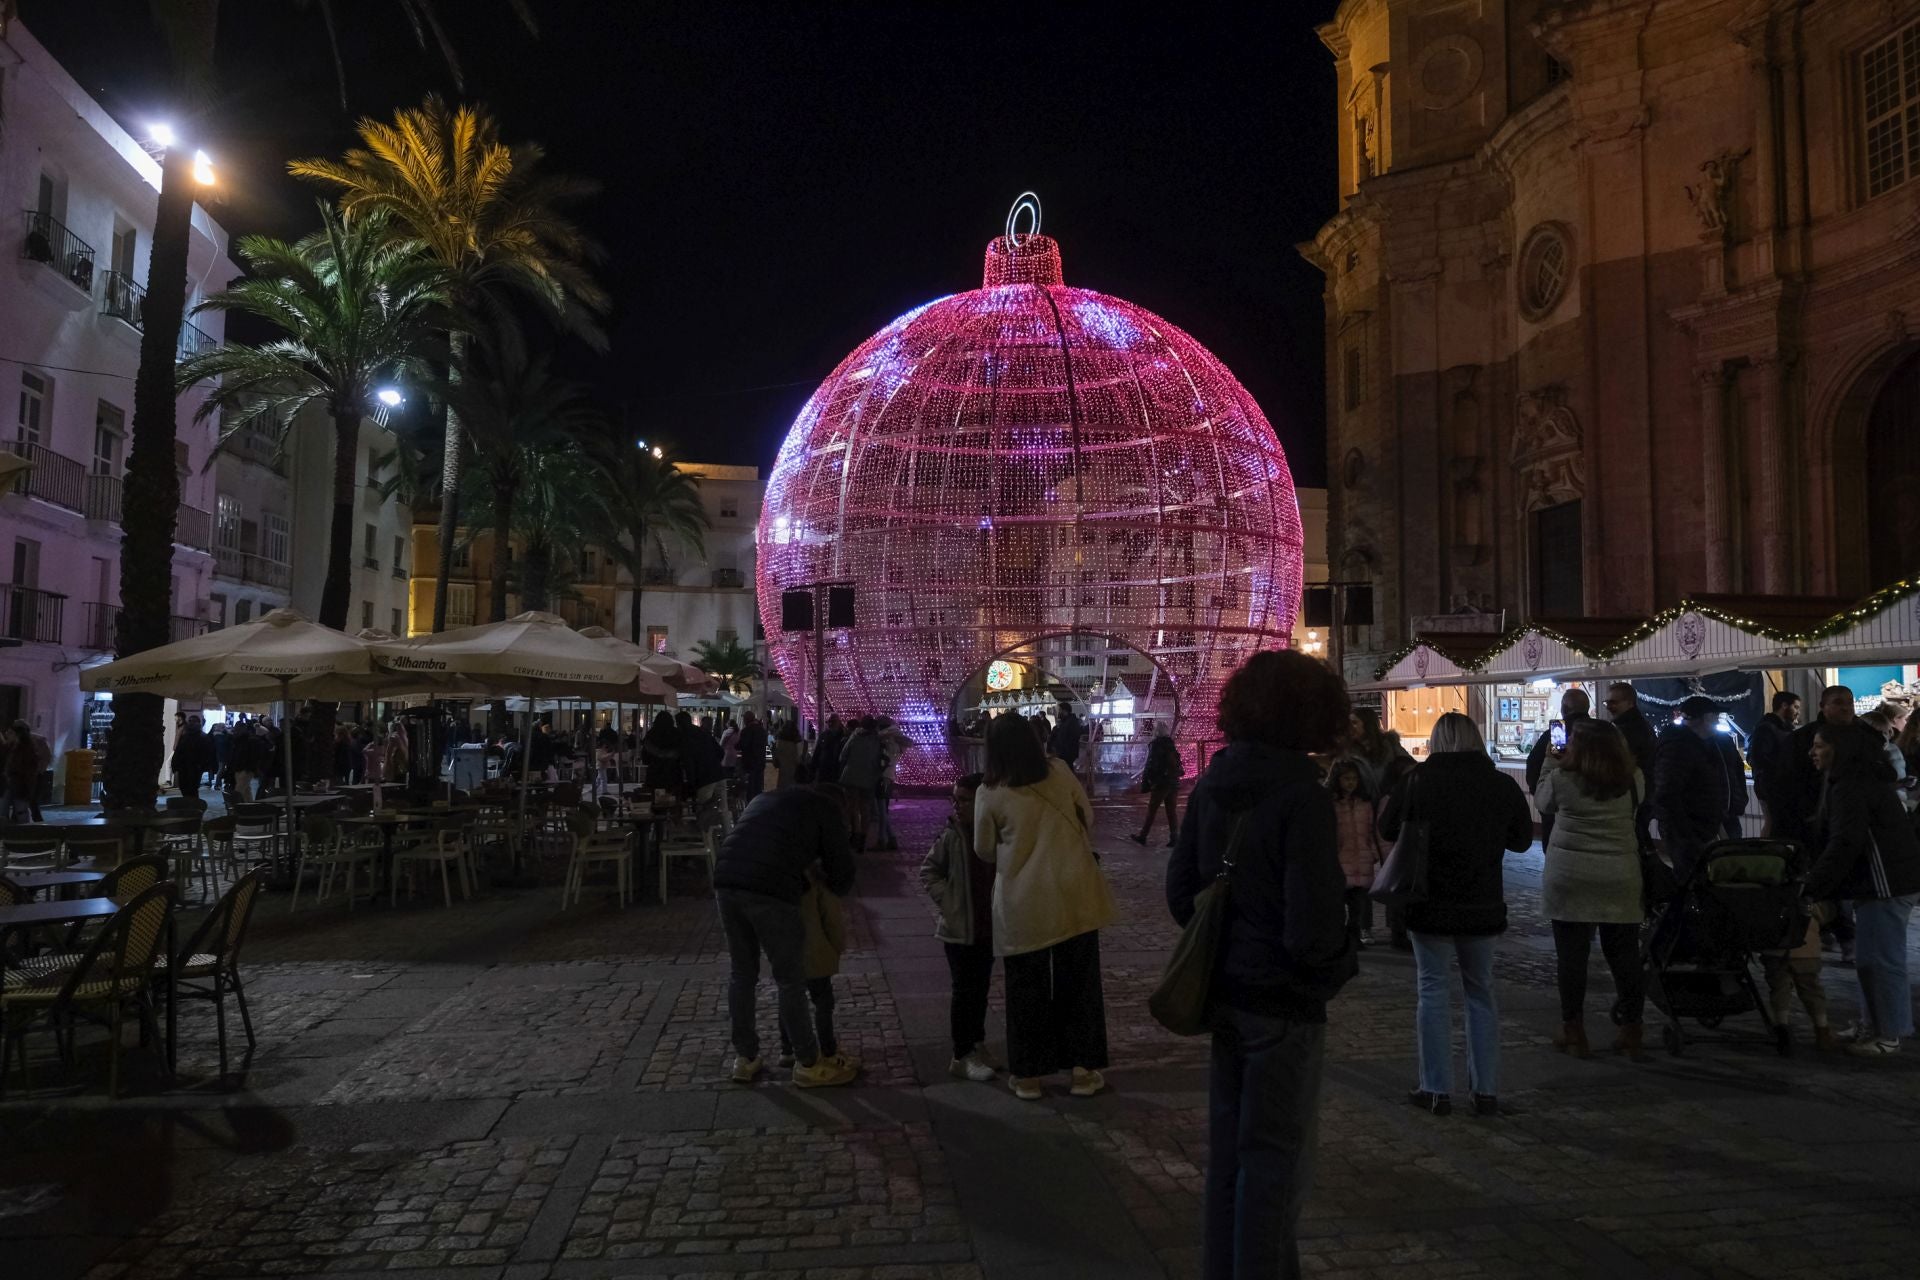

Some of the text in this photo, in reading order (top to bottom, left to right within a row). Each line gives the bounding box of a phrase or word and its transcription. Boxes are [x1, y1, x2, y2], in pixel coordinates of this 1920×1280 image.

[391, 655, 447, 671] Alhambra
[513, 666, 544, 677] CERVEZA
[569, 672, 582, 680] SIN
